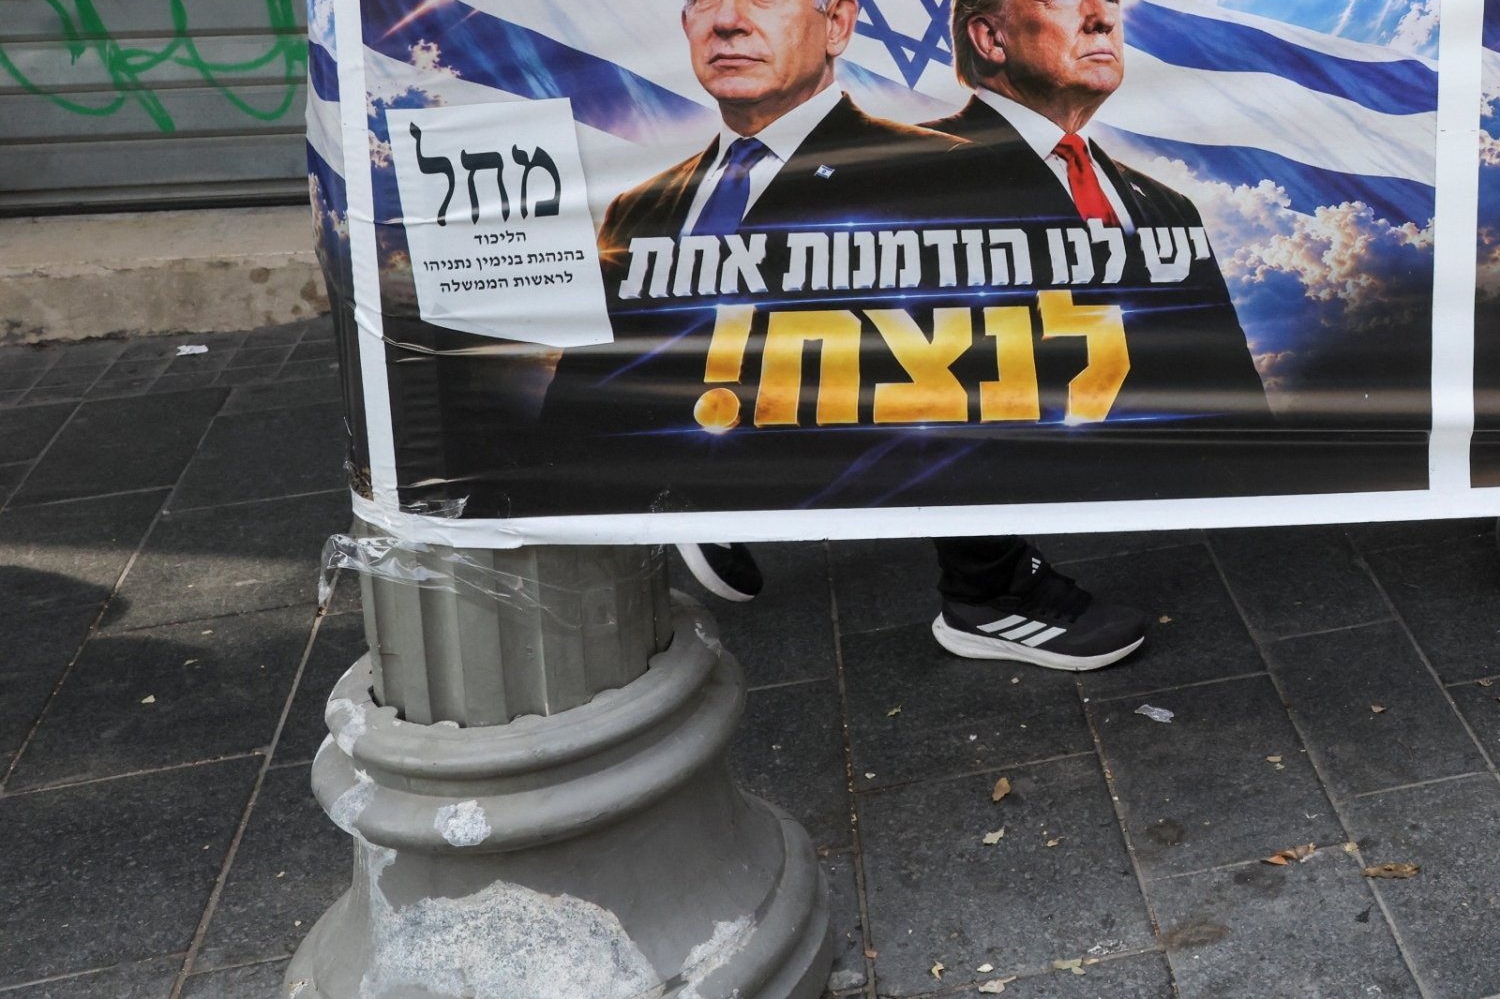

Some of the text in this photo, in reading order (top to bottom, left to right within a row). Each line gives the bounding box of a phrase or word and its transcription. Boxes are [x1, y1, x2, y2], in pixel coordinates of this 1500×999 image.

[409, 121, 561, 227] מחל
[424, 249, 585, 272] בהנהגת בנימין נתניהו
[474, 230, 527, 246] הליכוד
[618, 219, 1211, 299] יש לנו הזדמנות אחת
[440, 271, 573, 294] לראשות הממשלה
[694, 290, 1131, 433] לנצח!
